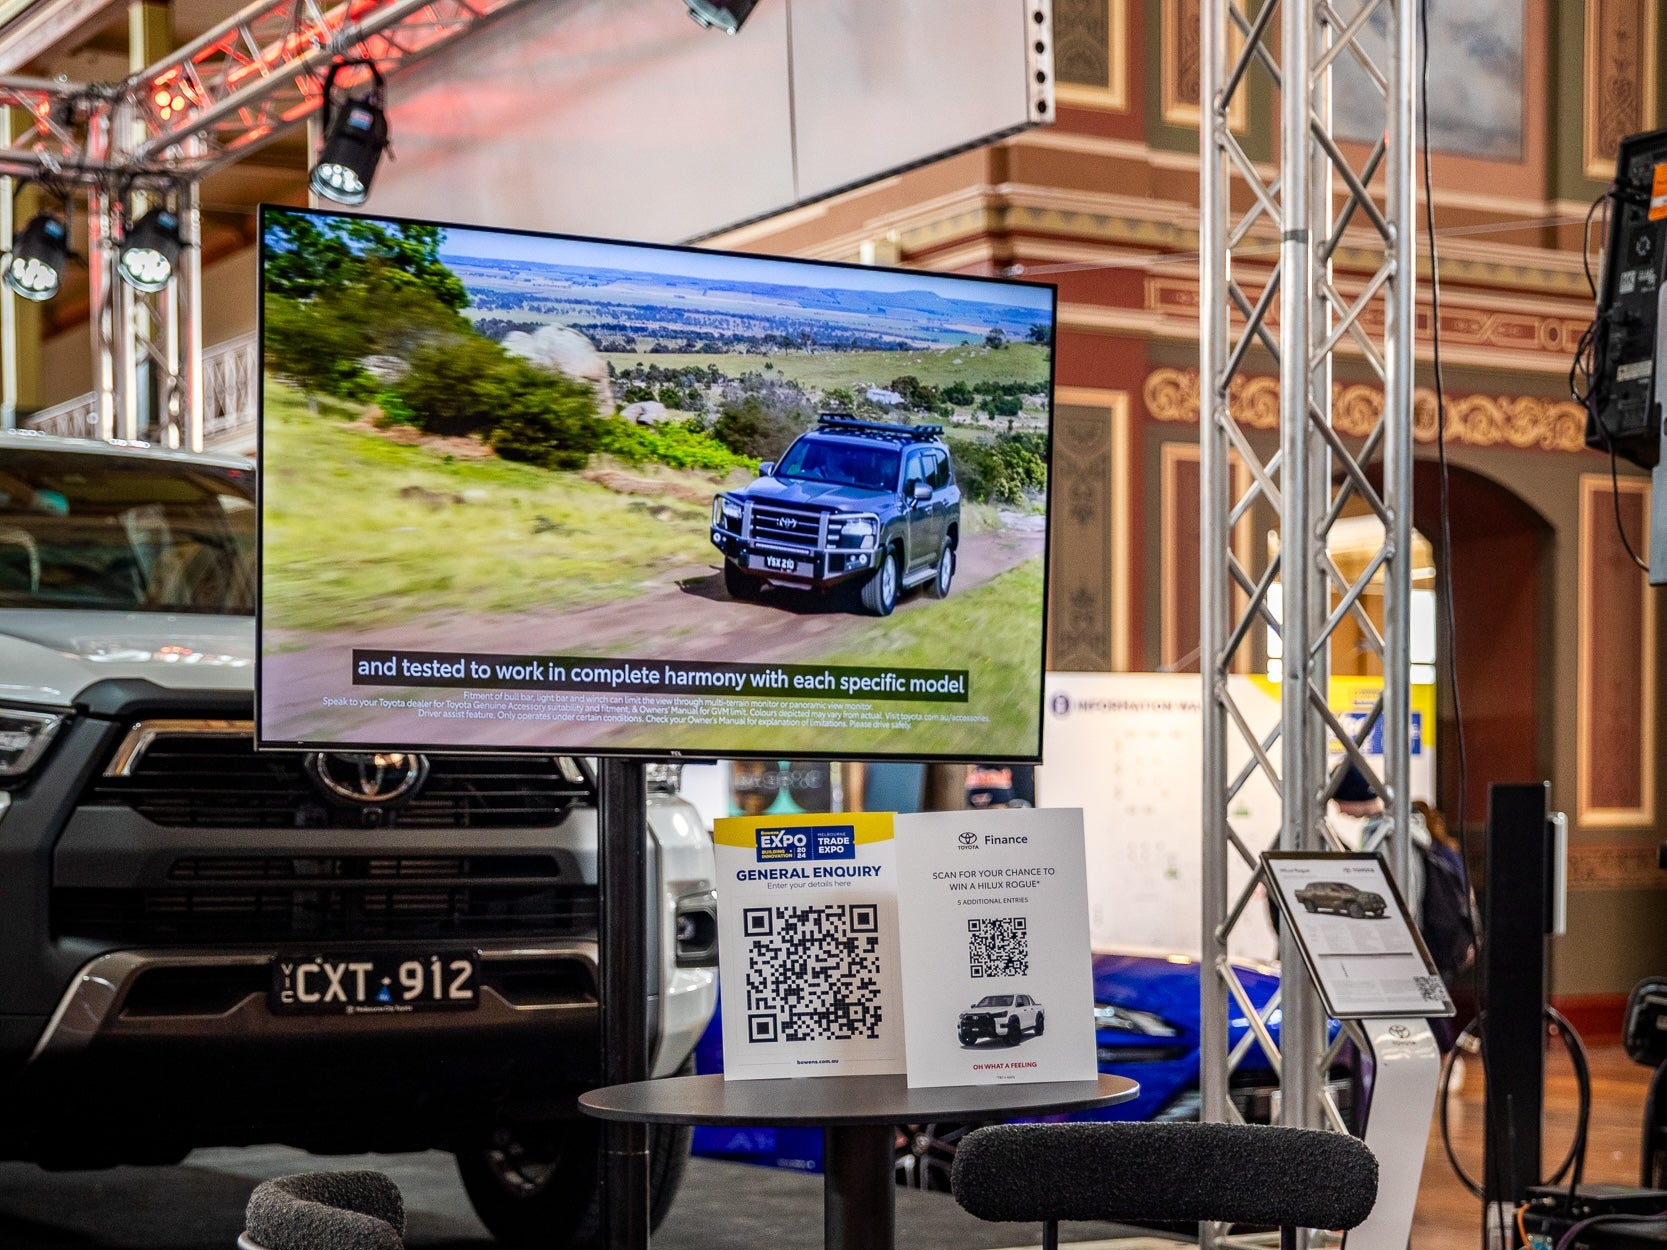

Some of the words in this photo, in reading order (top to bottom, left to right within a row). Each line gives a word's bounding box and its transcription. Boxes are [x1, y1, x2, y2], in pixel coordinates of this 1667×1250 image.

[357, 656, 397, 676] and
[401, 658, 465, 678] tested
[470, 661, 491, 679] to
[496, 661, 544, 681] work
[549, 662, 566, 682] in
[571, 664, 660, 688] complete
[665, 665, 746, 692] harmony
[750, 668, 789, 688] with
[793, 669, 835, 690] each
[840, 670, 906, 694] specific
[910, 674, 965, 694] model
[464, 691, 493, 700] Fitment
[495, 692, 504, 700] of
[504, 692, 520, 700] bull
[536, 694, 555, 703] light
[556, 694, 569, 702] bar
[570, 694, 584, 702] and
[585, 695, 608, 704] winch
[609, 696, 623, 704] can
[624, 696, 642, 704] limit
[642, 696, 655, 704] the
[656, 697, 673, 705] view
[674, 698, 704, 707] through
[751, 700, 779, 708] monitor
[788, 700, 826, 710] panoramic
[828, 702, 842, 710] view
[322, 697, 348, 707] Speak
[350, 698, 358, 706] to
[360, 700, 378, 709] your
[378, 698, 406, 709] Toyota
[406, 698, 432, 708] dealer
[433, 700, 444, 708] for
[446, 700, 472, 711] Toyota
[473, 701, 507, 710] Genuine
[508, 702, 546, 713] Accessory
[548, 703, 584, 714] suitability
[585, 704, 600, 712] and
[671, 706, 698, 715] Manual
[700, 707, 709, 715] for
[711, 708, 730, 716] GVM
[750, 708, 777, 717] Colours
[778, 708, 810, 719] depicted
[812, 712, 826, 720] may
[827, 712, 842, 720] vary
[843, 711, 859, 719] from
[418, 710, 442, 718] Driver
[443, 710, 464, 718] assist
[498, 711, 516, 720] Only
[518, 712, 551, 722] operates
[552, 712, 574, 720] under
[576, 714, 602, 722] certain
[646, 715, 668, 724] Check
[669, 717, 686, 725] your
[719, 716, 746, 725] Manual
[747, 717, 758, 725] for
[758, 718, 800, 727] explanation
[802, 718, 809, 726] of
[850, 720, 872, 728] Please
[872, 720, 890, 729] drive
[760, 830, 806, 848] EXPO
[818, 837, 850, 845] TRADE
[984, 835, 1028, 845] Finance
[818, 846, 844, 854] EXPO
[736, 868, 810, 881] GENERAL
[813, 866, 882, 878] ENQUIRY
[932, 871, 957, 880] SCAN
[959, 870, 976, 878] FOR
[979, 870, 1004, 878] YOUR
[1005, 868, 1041, 876] CHANCE
[1044, 868, 1056, 876] TO
[768, 882, 788, 890] Enter
[789, 882, 807, 890] your
[808, 880, 833, 888] details
[950, 883, 968, 891] WIN
[970, 882, 976, 890] A
[978, 882, 1004, 890] HILUX
[1003, 896, 1029, 904] ENTRIES
[280, 963, 294, 1004] VIC
[296, 962, 374, 1003] CXT
[398, 960, 474, 1000] 912
